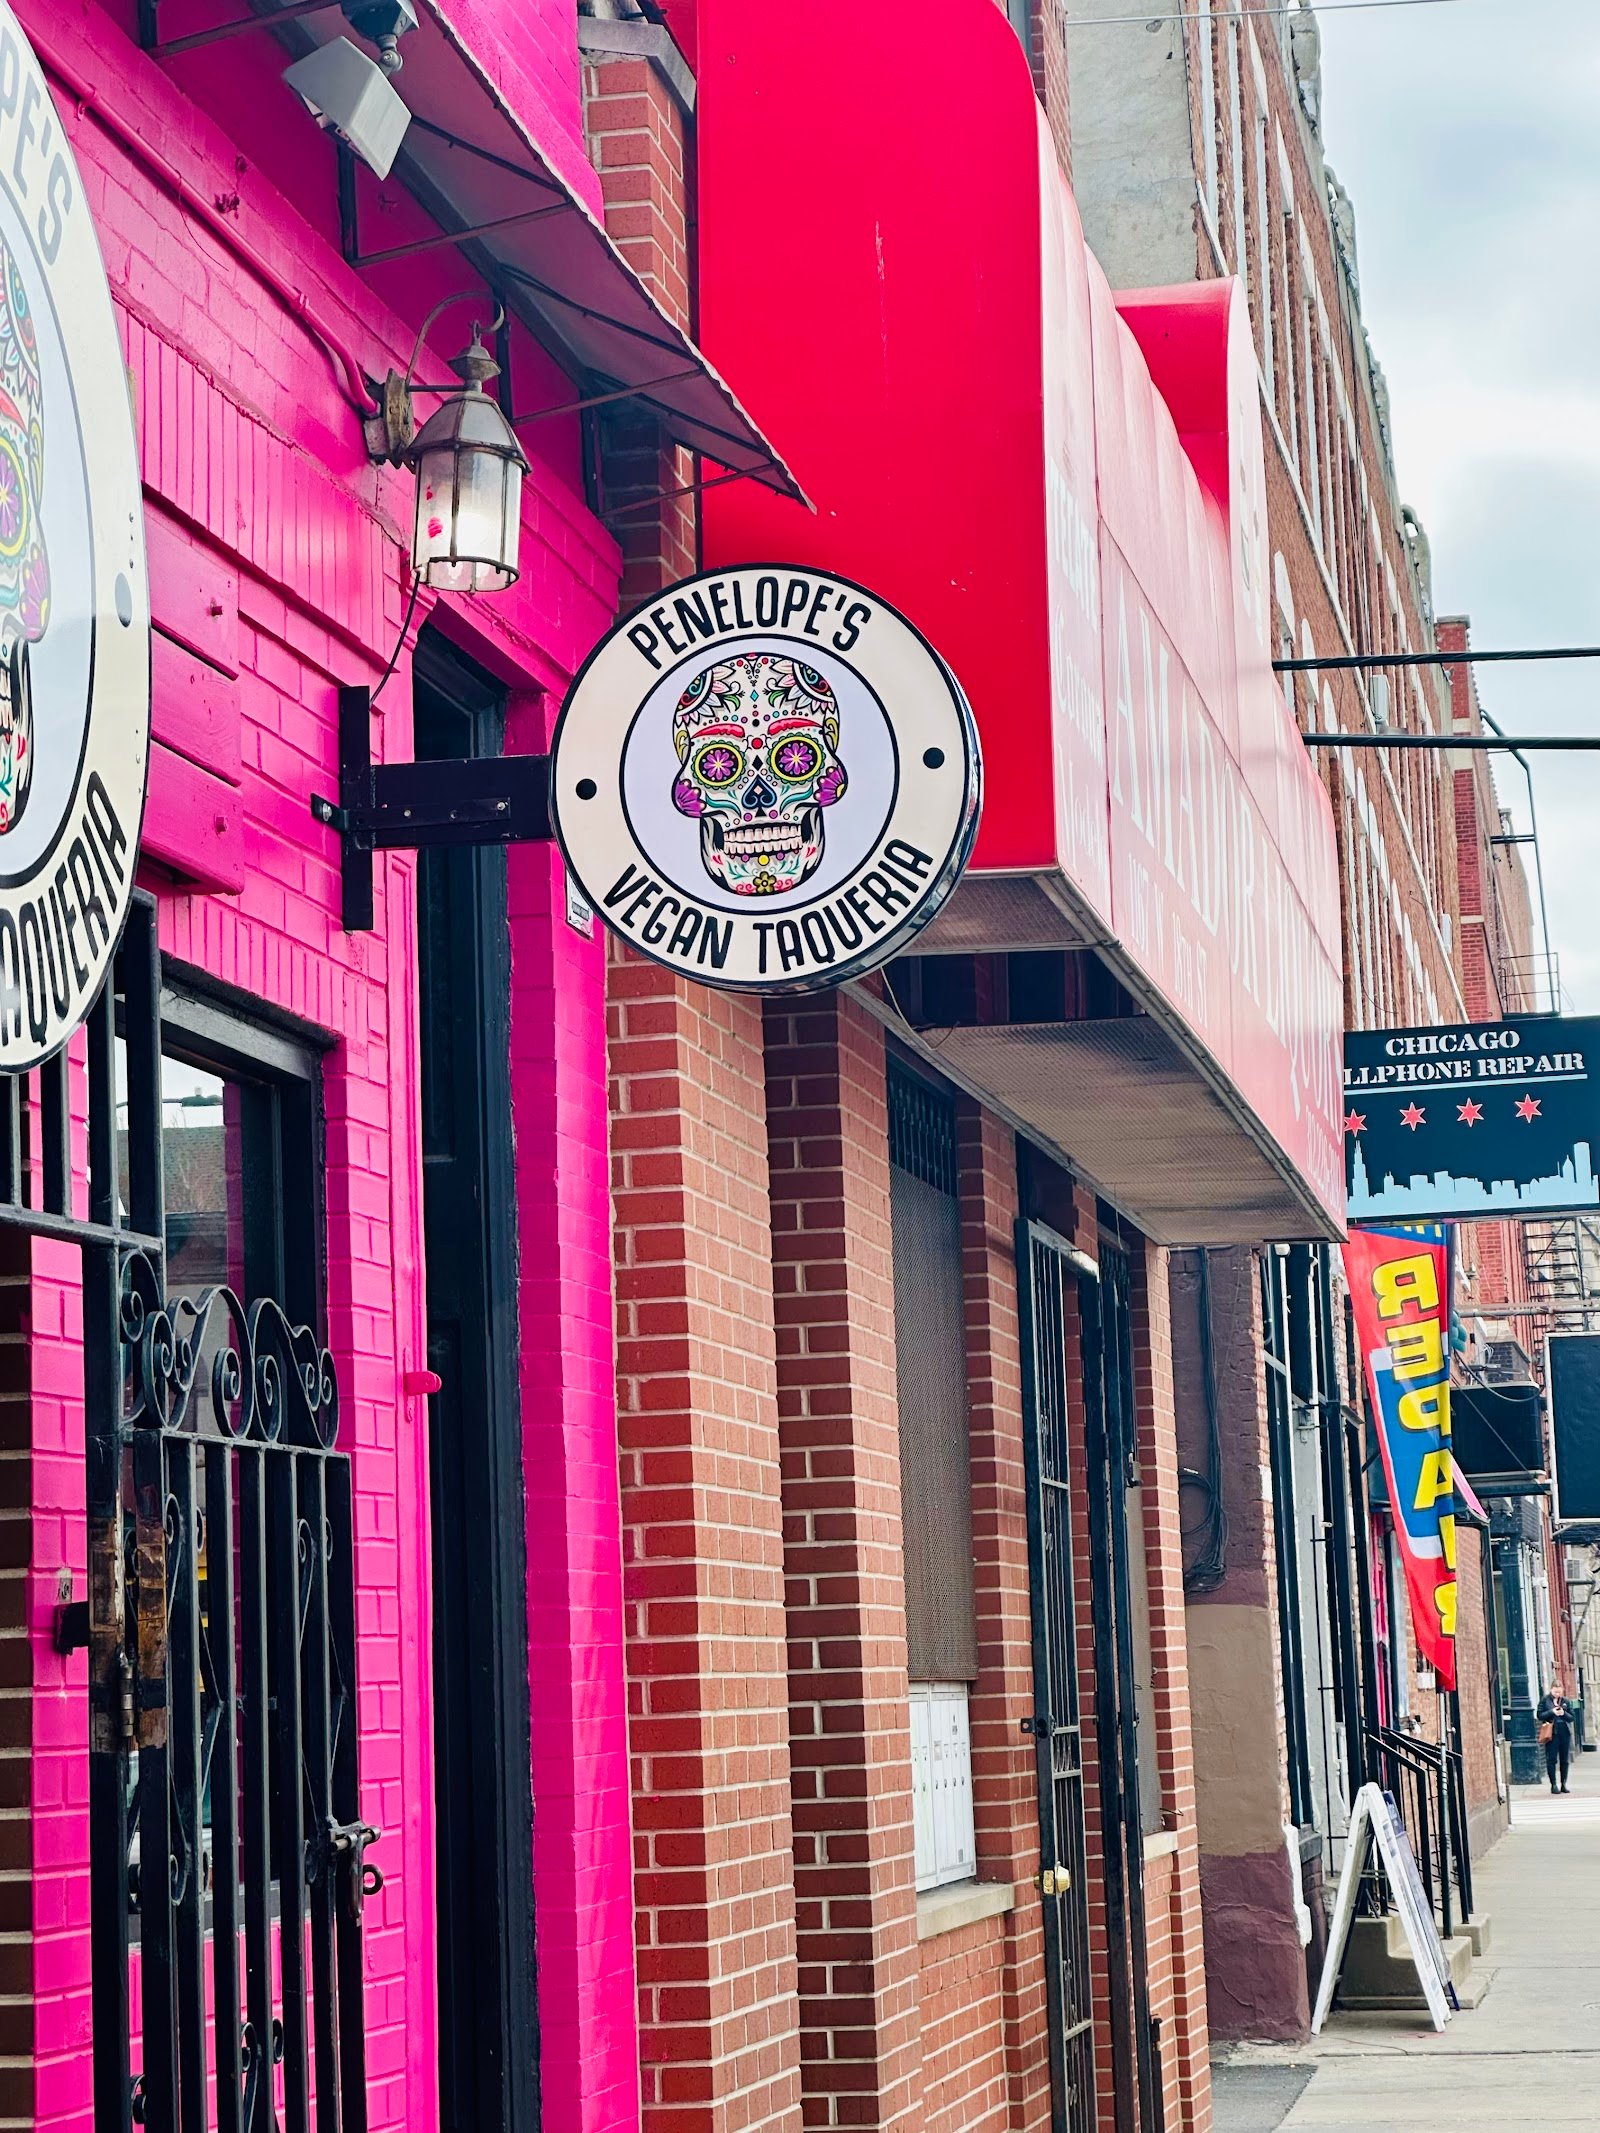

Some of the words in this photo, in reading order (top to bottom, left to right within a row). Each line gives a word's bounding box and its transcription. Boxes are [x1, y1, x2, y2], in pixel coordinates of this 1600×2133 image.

[627, 576, 871, 670] PENELOPE'S
[1113, 567, 1260, 1008] AMADOR
[1262, 834, 1343, 1145] LIQUORS
[603, 864, 734, 969] VEGAN
[753, 839, 934, 974] TAQUERIA
[1385, 1030, 1520, 1056] CHICAGO
[1477, 1052, 1585, 1077] REPAIR
